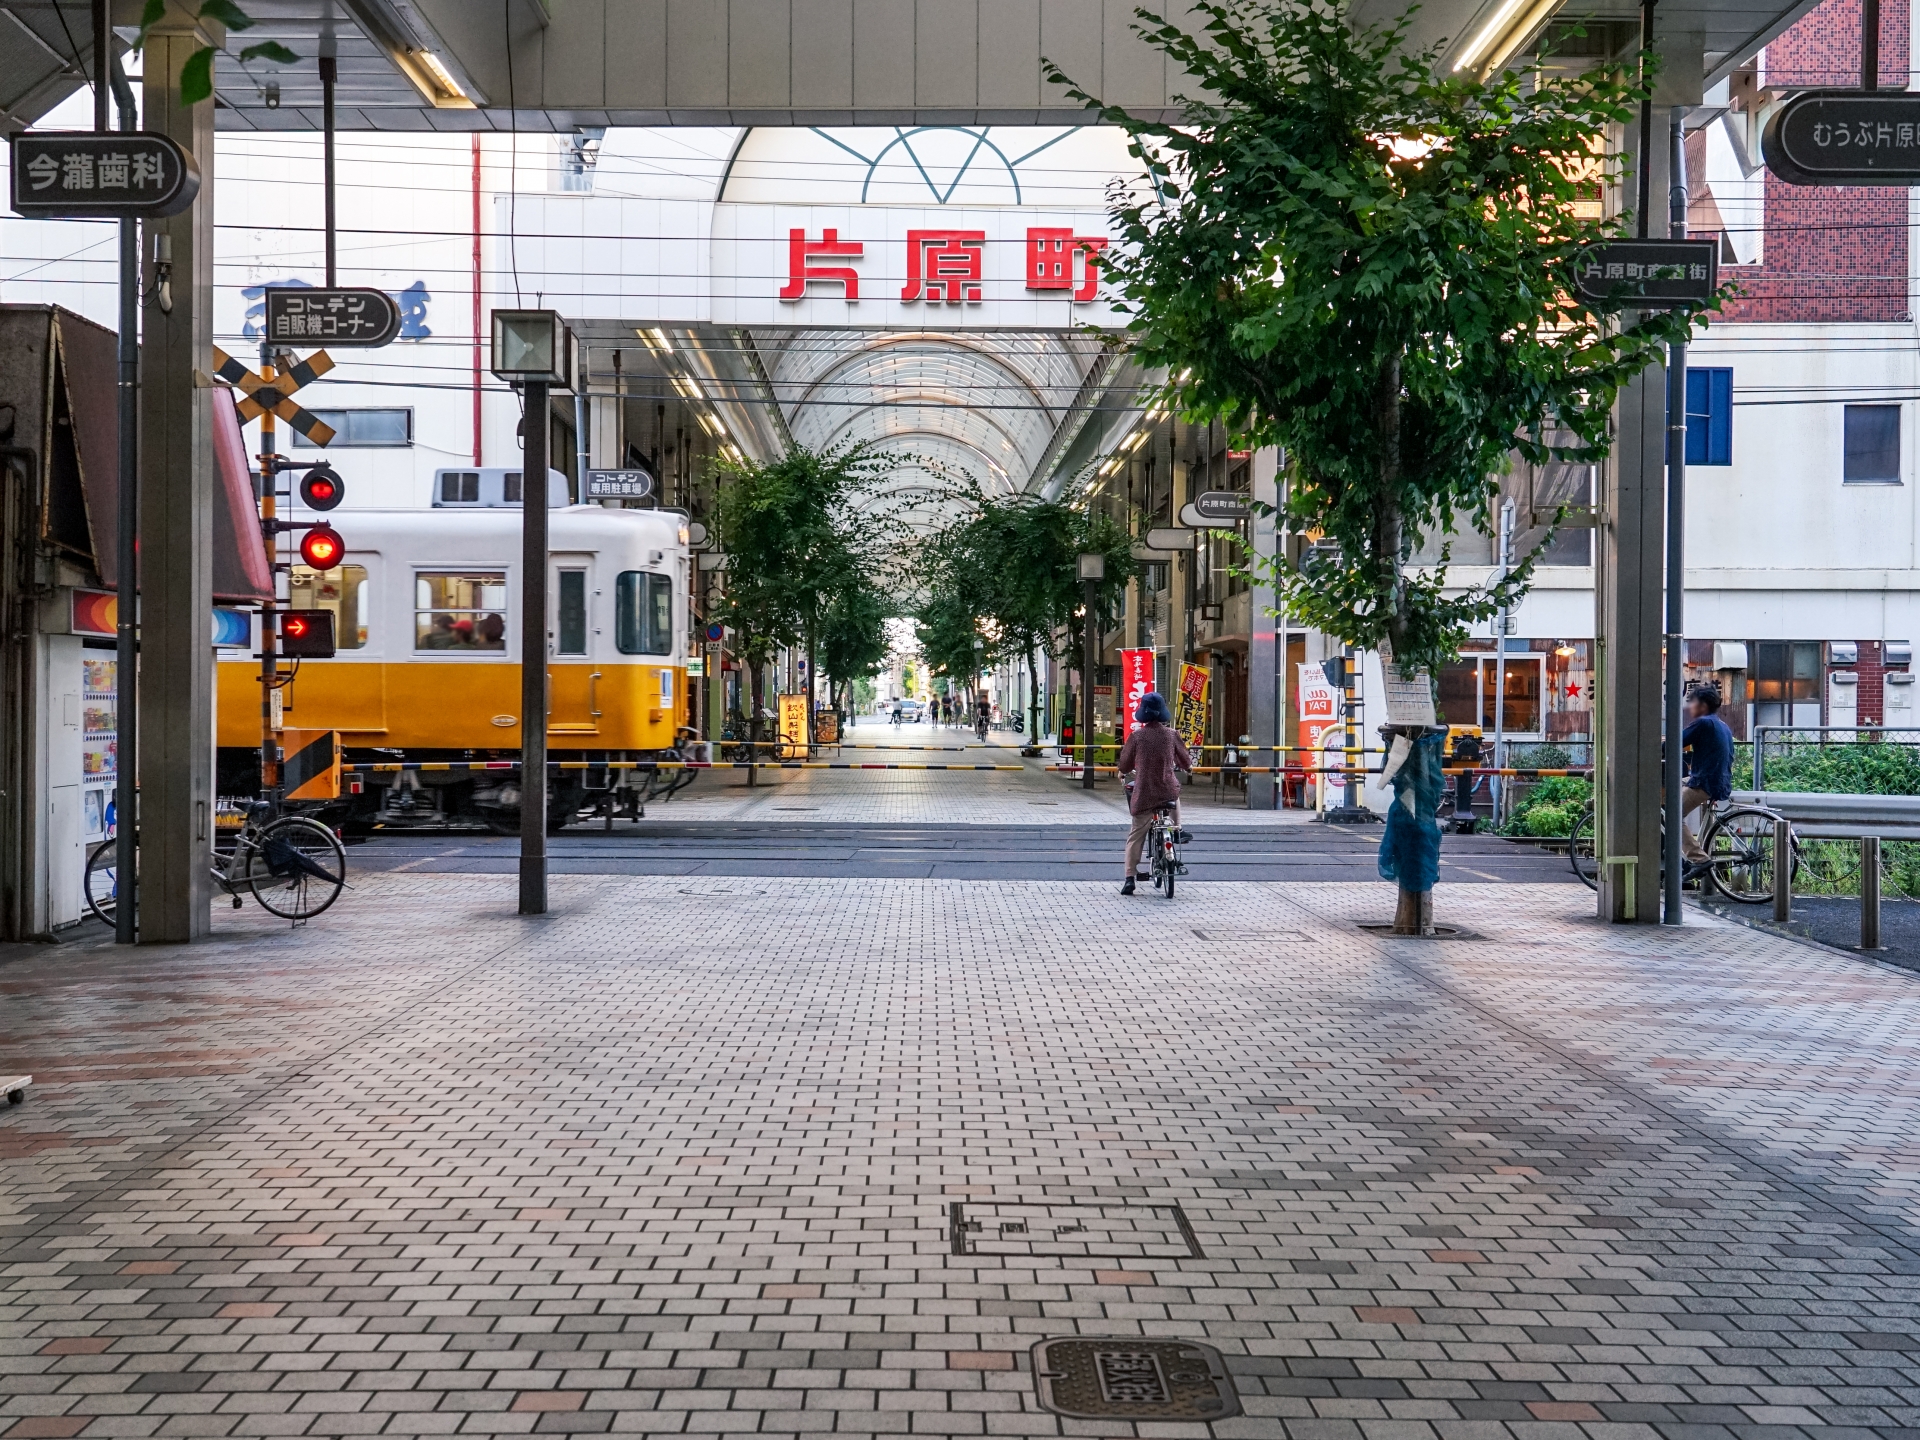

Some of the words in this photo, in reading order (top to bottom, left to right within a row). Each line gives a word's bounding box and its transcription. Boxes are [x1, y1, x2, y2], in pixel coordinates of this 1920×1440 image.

[1813, 121, 1920, 148] むうぶ片原
[26, 152, 165, 191] 今瀧歯科
[779, 226, 1109, 304] 片原町
[286, 295, 366, 313] コトデン
[275, 314, 375, 336] 自販機コーナー
[595, 472, 638, 483] コトデン
[590, 483, 642, 495] 専用駐車場
[1202, 500, 1250, 508] 片原町商店
